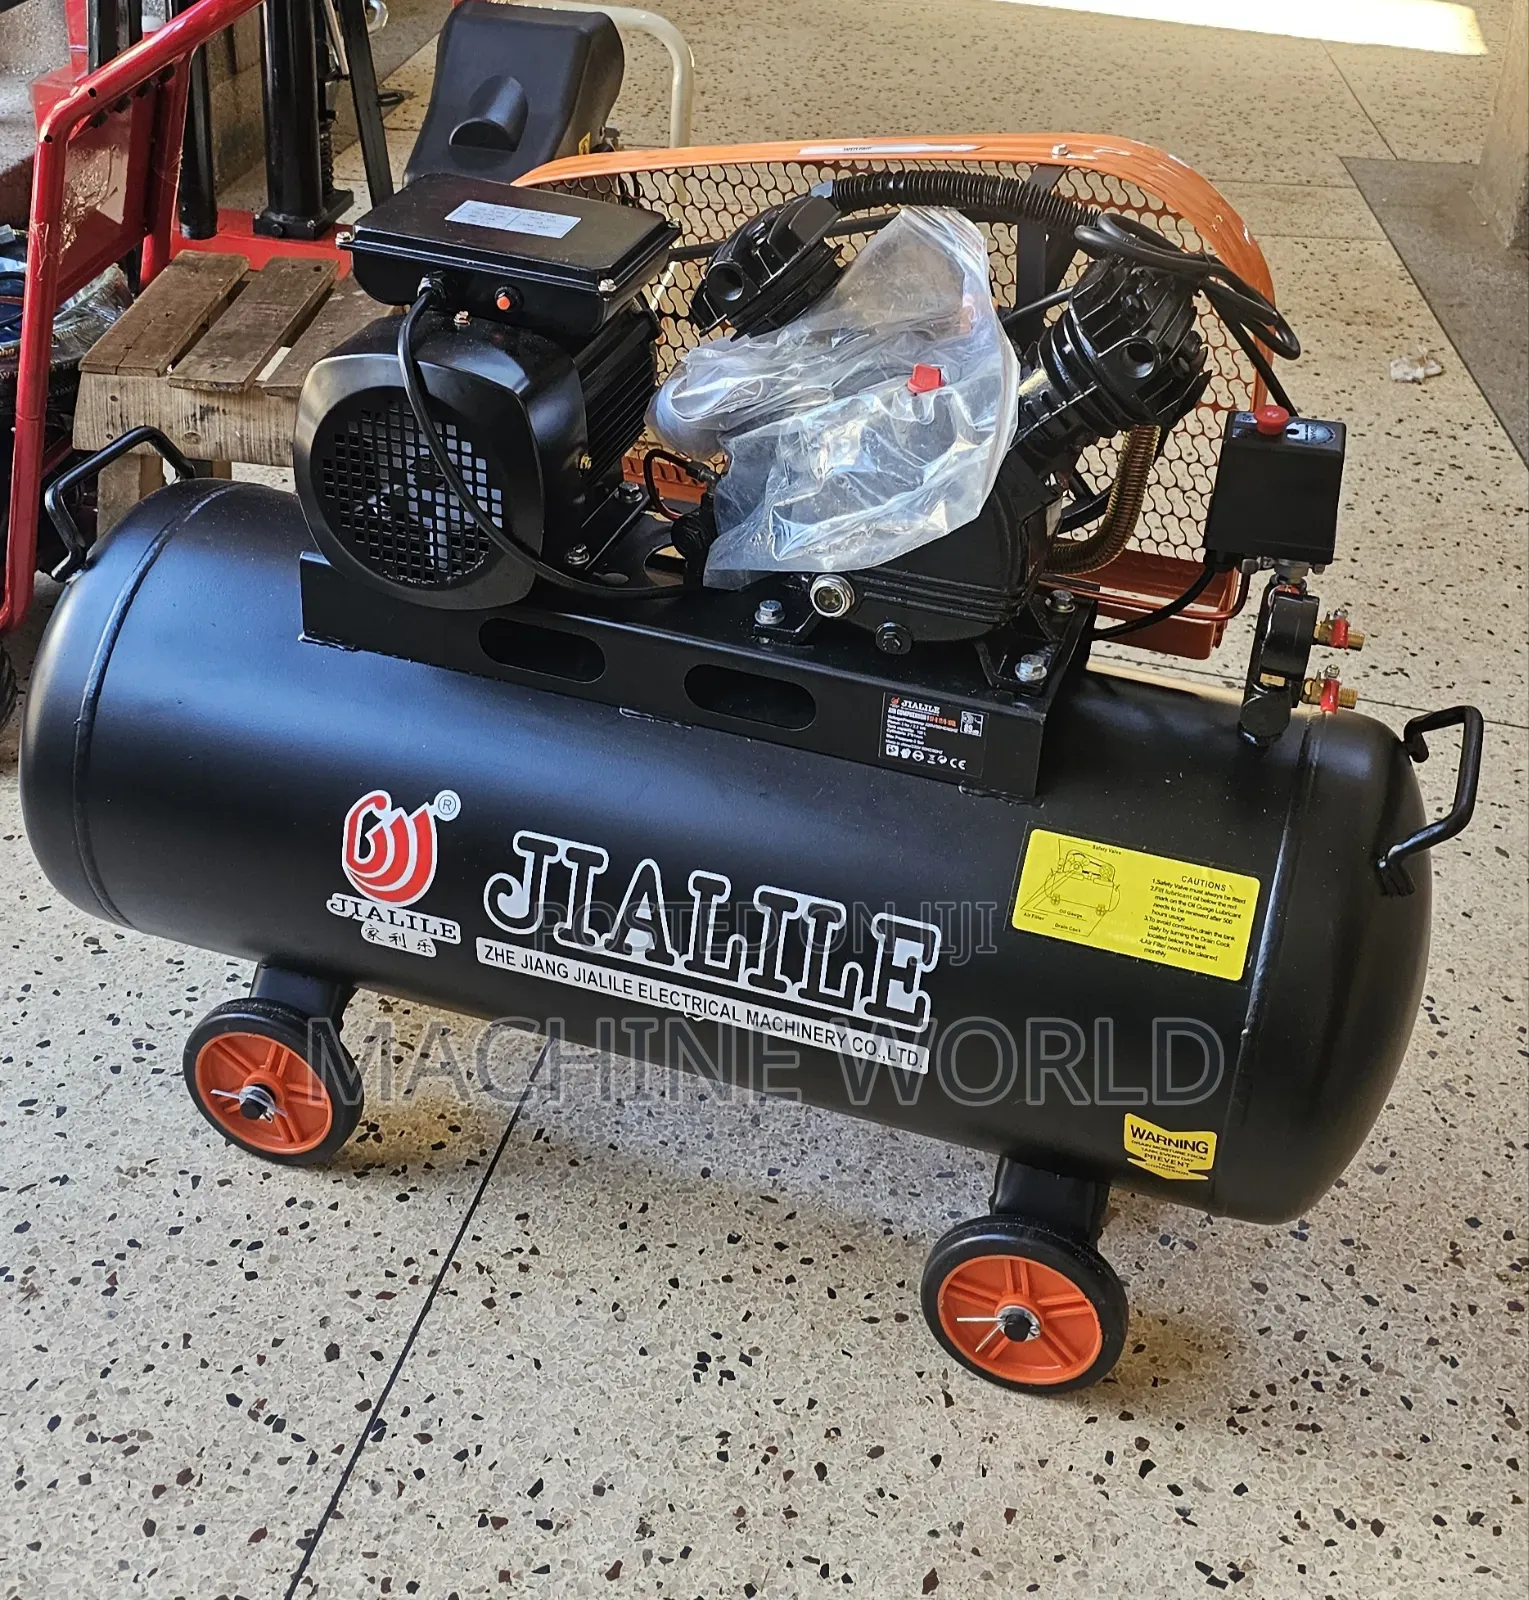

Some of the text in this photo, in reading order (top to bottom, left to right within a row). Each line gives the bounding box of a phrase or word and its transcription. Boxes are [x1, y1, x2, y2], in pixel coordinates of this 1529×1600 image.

[901, 700, 940, 714] JIALILE
[1174, 883, 1188, 891] Valve
[1204, 891, 1223, 900] always
[1182, 876, 1226, 892] CAUTIONS
[1165, 888, 1192, 900] lubricant
[1200, 897, 1217, 905] below
[330, 897, 456, 940] JIALILE
[1152, 909, 1185, 922] hours usage
[1185, 910, 1209, 919] renewed
[1215, 908, 1242, 919] Lubricant
[1156, 919, 1172, 927] avoid
[364, 924, 432, 954] 家利乐
[484, 830, 941, 1033] JIALILE
[1147, 932, 1167, 941] located
[1168, 936, 1184, 945] below
[1149, 925, 1162, 933] daily
[1170, 930, 1190, 940] turning
[1200, 936, 1215, 944] Drain
[1216, 940, 1230, 948] Cock
[1144, 948, 1166, 958] monthly
[1196, 952, 1218, 961] cleaned
[484, 944, 923, 1069] ZHE JIANG JIALILE ELECTRICAL MACHINERY CO.,LTD.
[1131, 1124, 1208, 1154] WARNING
[1144, 1153, 1190, 1168] PREVENT
[1160, 1151, 1180, 1159] EVERY
